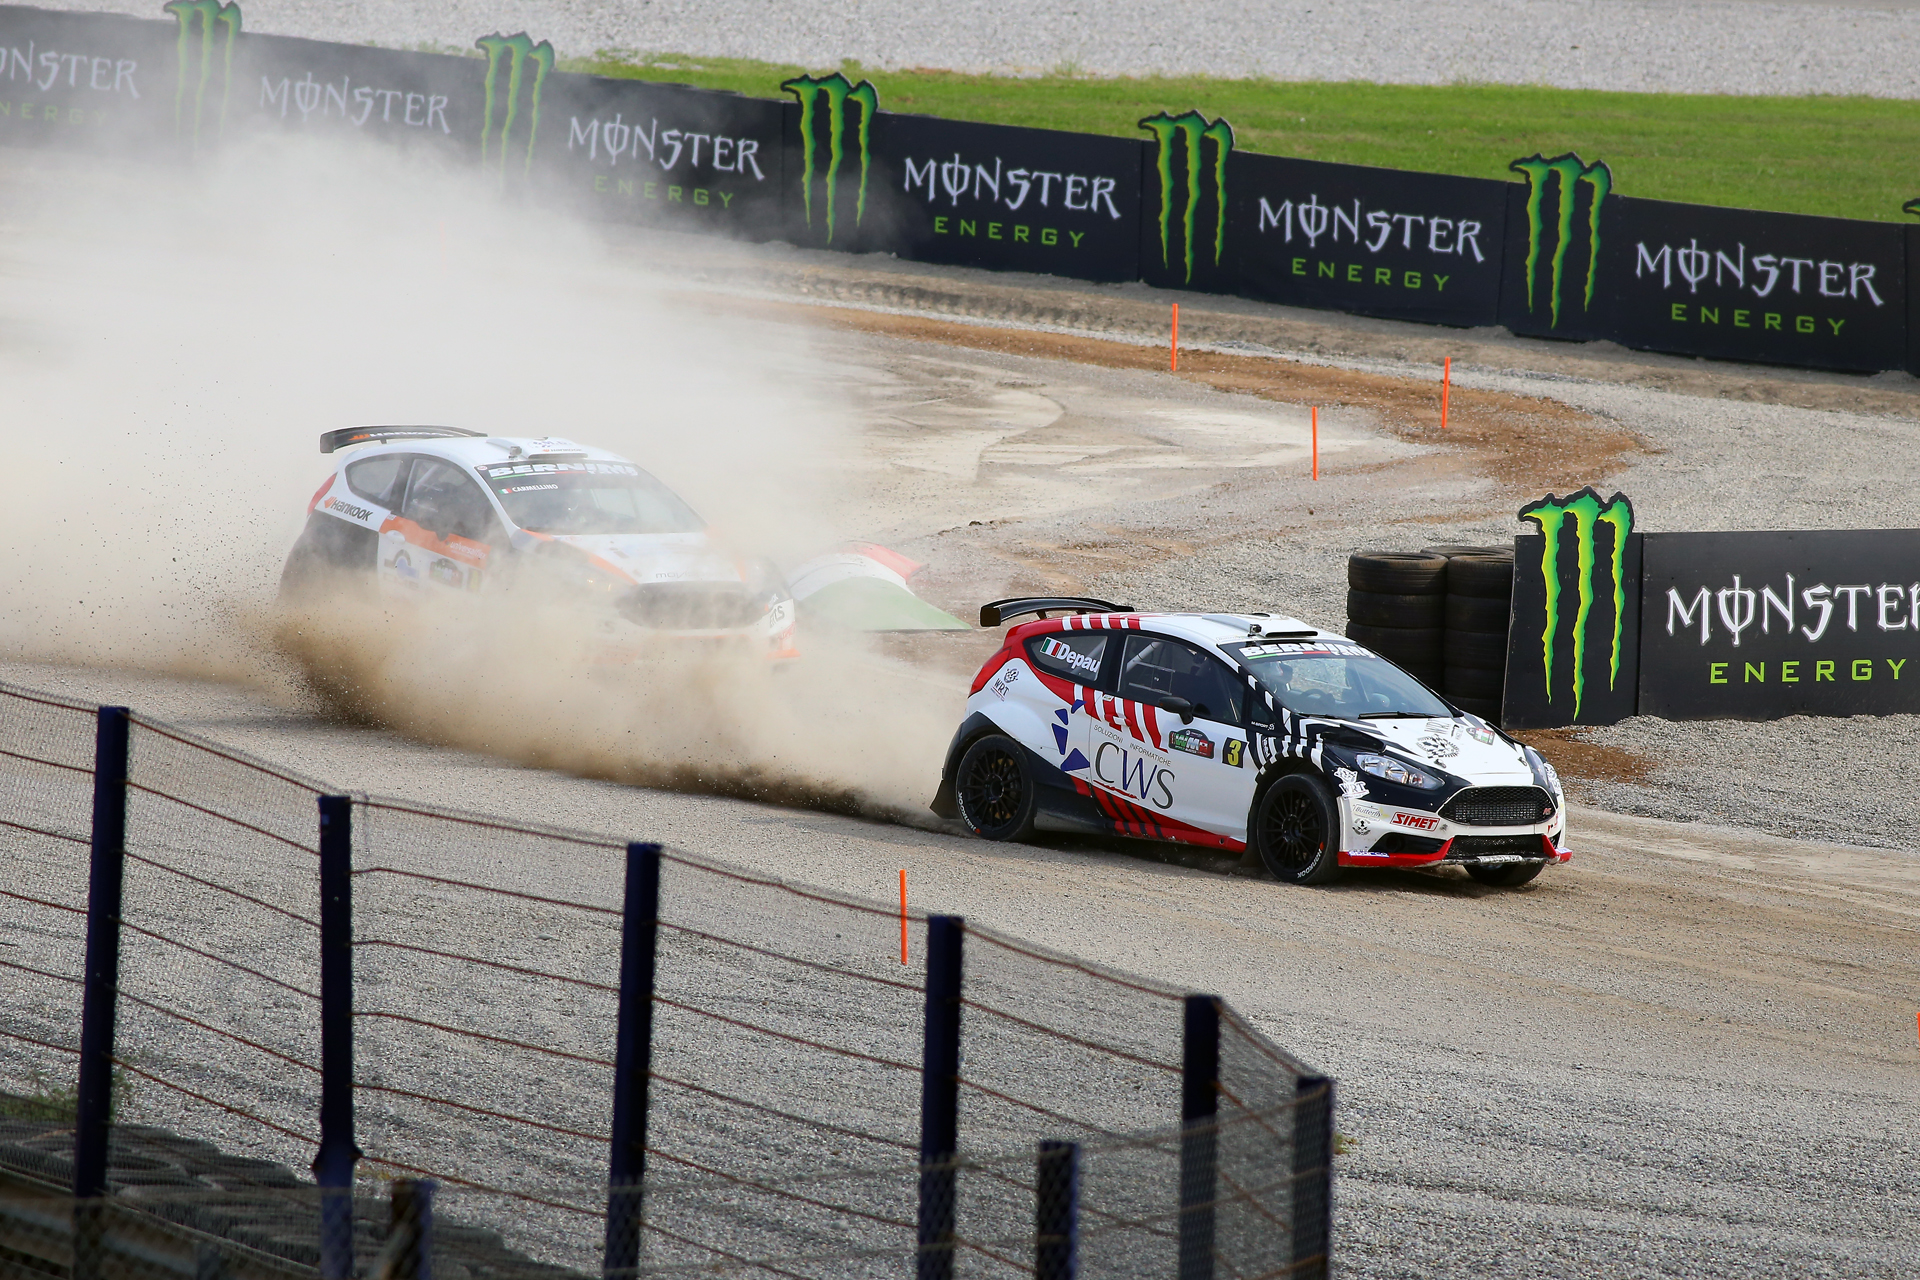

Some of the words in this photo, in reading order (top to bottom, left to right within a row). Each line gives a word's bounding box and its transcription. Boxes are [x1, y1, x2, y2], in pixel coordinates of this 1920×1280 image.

[260, 71, 450, 134] MONSTER
[568, 113, 765, 181] MONSTER
[594, 174, 734, 208] ENERGY
[903, 153, 1122, 219] MONSTER
[934, 216, 1085, 248] ENERGY
[1258, 194, 1485, 263] MONSTER
[1292, 257, 1450, 292] ENERGY
[1635, 238, 1884, 306] MONSTER
[1671, 303, 1845, 336] ENERGY
[511, 484, 558, 493] CARMELLINO
[1666, 571, 1920, 646] MONSTE
[1056, 643, 1100, 673] Depau
[1710, 658, 1907, 684] ENERGY
[1094, 724, 1123, 744] SOLUZIONI
[1130, 742, 1172, 767] INFORMATICHE
[1227, 739, 1242, 766] 3
[1095, 741, 1175, 809] CWS
[1354, 806, 1381, 818] Butterfly
[1392, 813, 1438, 830] SIMET
